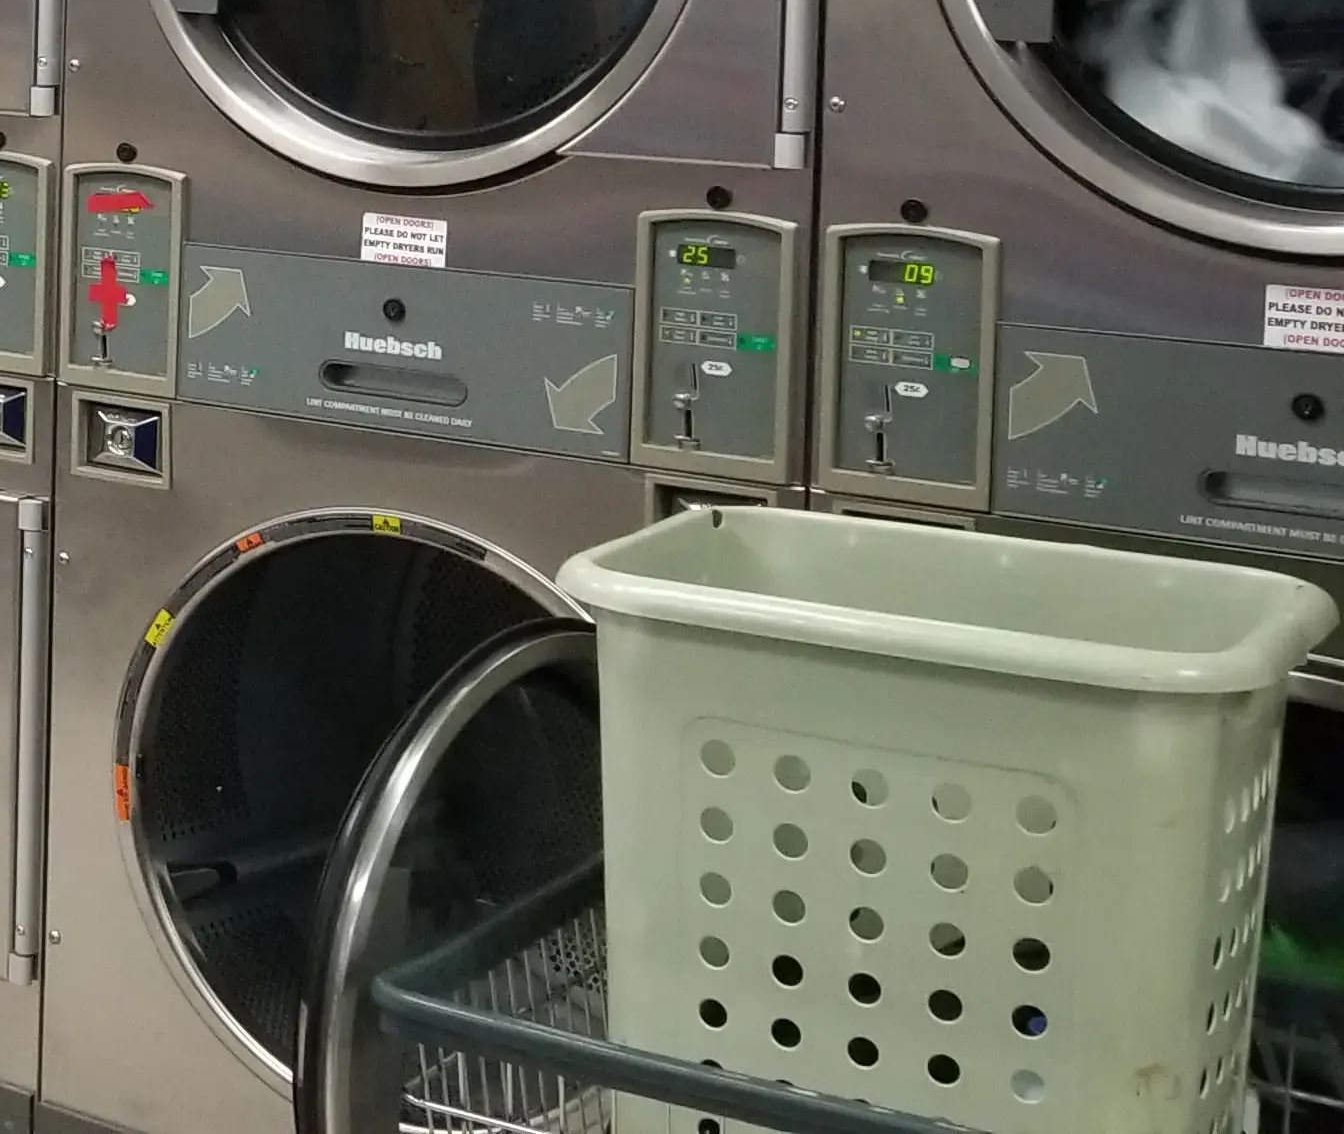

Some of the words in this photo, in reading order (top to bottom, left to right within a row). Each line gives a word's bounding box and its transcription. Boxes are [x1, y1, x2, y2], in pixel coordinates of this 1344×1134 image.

[365, 227, 394, 237] PLEASE
[397, 230, 407, 238] DO
[411, 232, 427, 241] NOT
[429, 234, 444, 243] LET
[364, 239, 391, 249] EMPTY
[393, 243, 424, 253] DRYERS
[427, 246, 444, 255] RUN
[682, 245, 708, 265] 25
[904, 264, 934, 284] 09
[1268, 301, 1313, 315] PLEASE
[1315, 305, 1332, 316] DO
[1267, 317, 1307, 329] EMPTY
[344, 331, 442, 360] Huebsch
[1180, 514, 1203, 525] LINT
[1205, 518, 1288, 536] COMPARTMENT
[1289, 528, 1322, 541] MUST
[1323, 533, 1337, 543] BE
